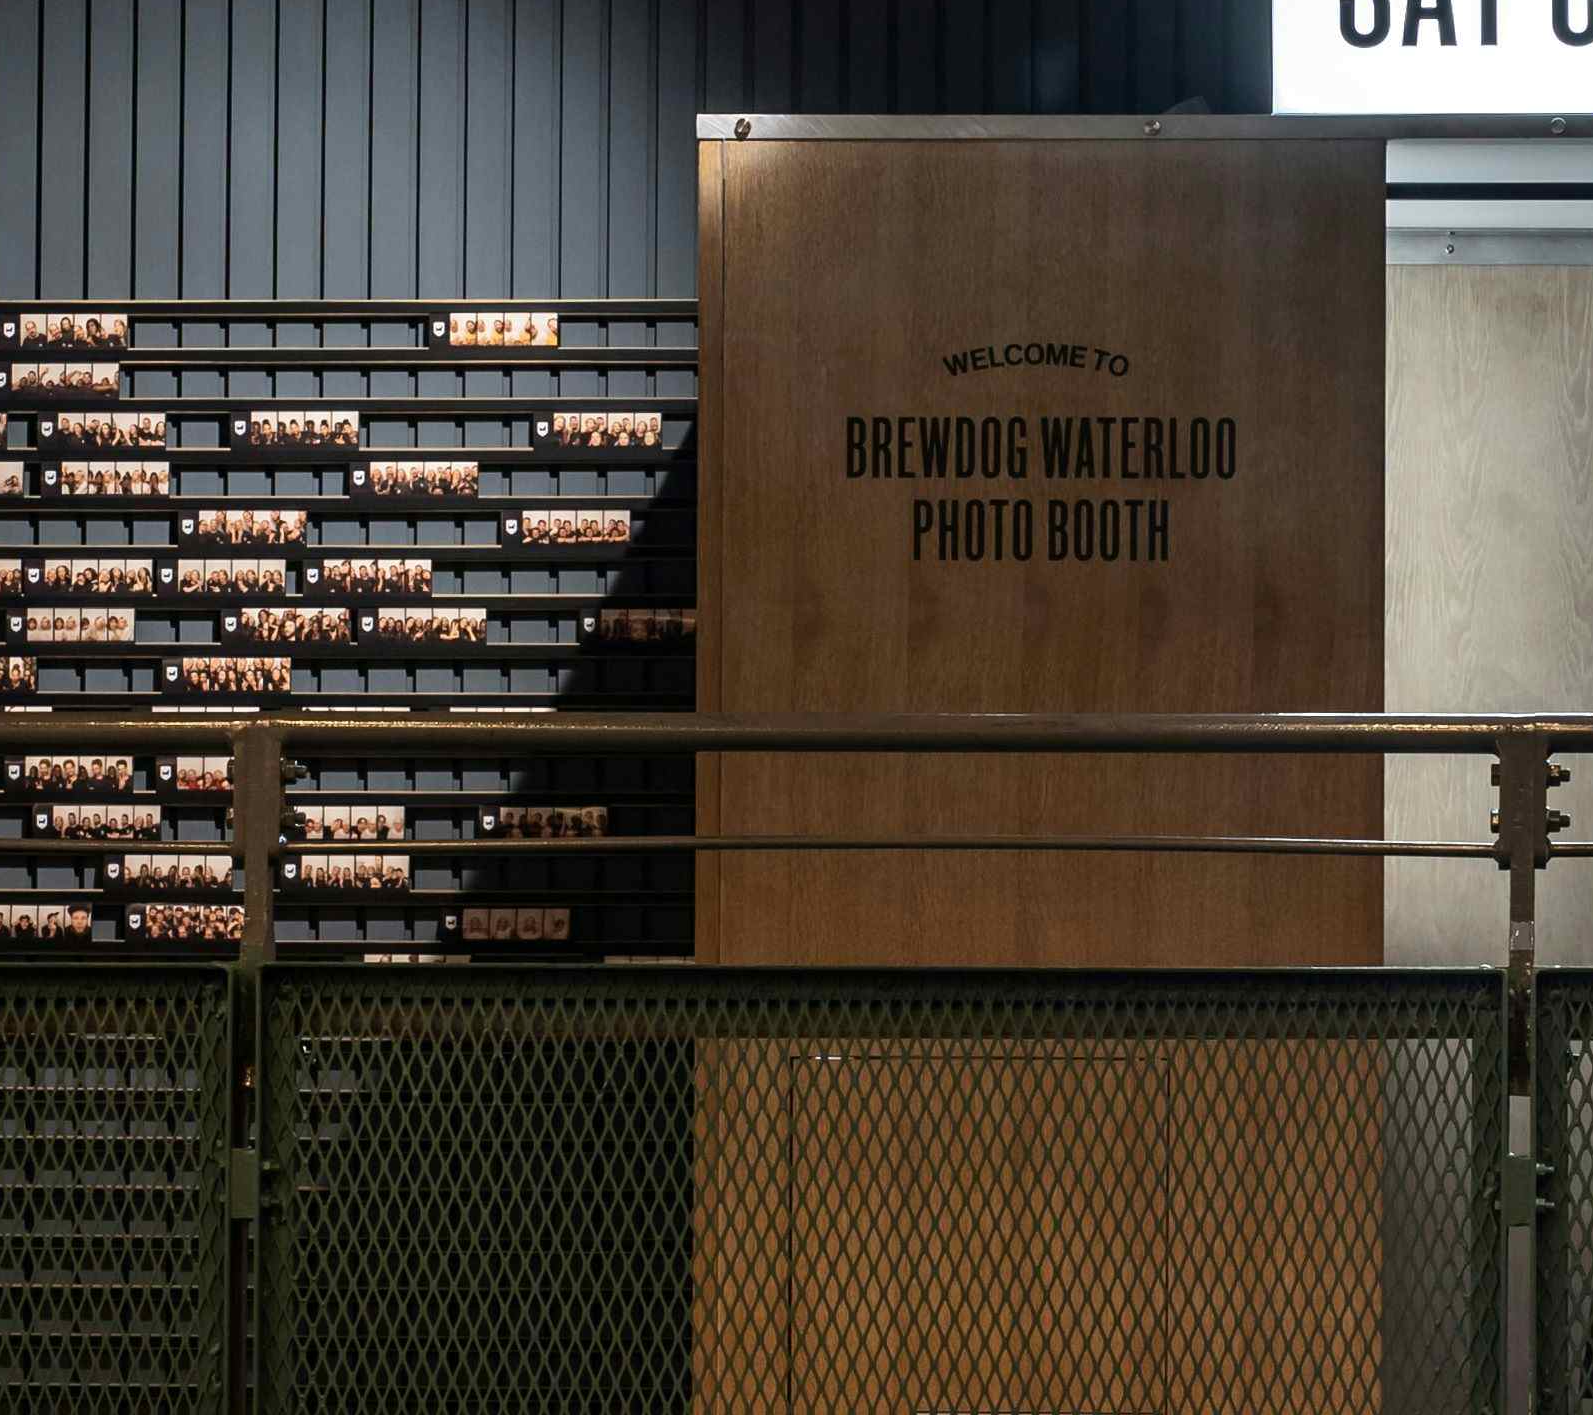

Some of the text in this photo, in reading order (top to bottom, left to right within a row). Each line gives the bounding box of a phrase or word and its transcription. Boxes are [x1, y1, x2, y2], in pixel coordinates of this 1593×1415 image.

[943, 343, 1129, 377] WELCOME TO
[846, 417, 1237, 479] BREWDOG WATERLOO
[913, 499, 1169, 561] PHOTO BOOTH
